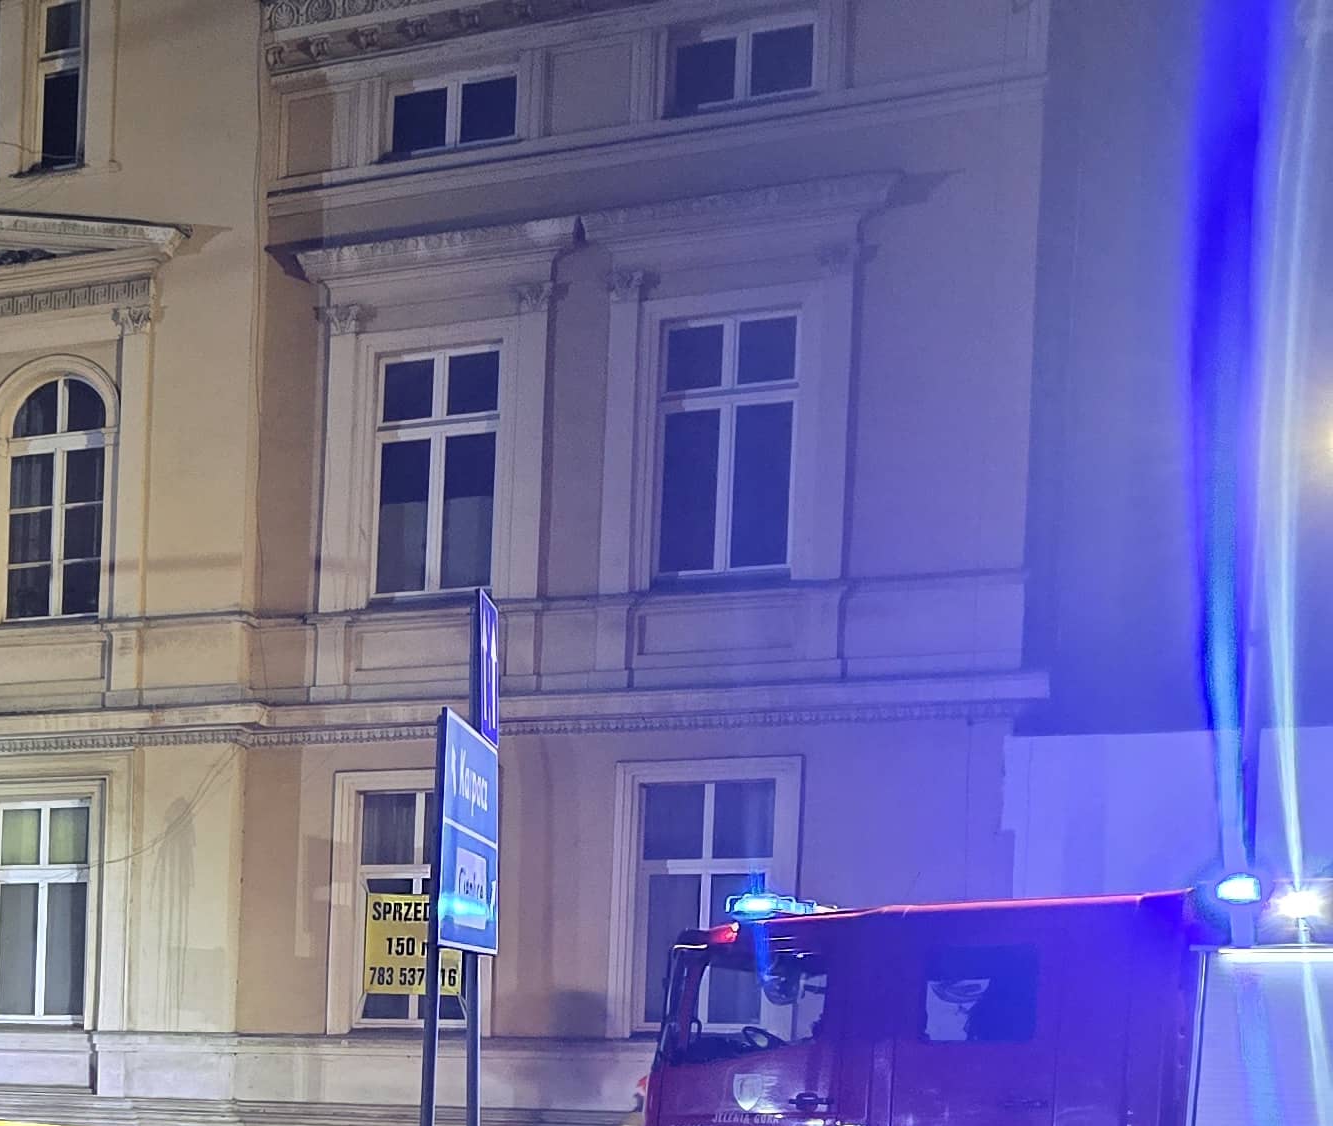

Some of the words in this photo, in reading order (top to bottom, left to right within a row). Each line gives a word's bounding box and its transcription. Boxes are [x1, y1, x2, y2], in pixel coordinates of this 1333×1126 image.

[458, 747, 488, 817] Karpacz
[387, 937, 415, 956] 150
[369, 966, 394, 985] 783
[399, 967, 425, 986] 537
[440, 968, 457, 987] 16
